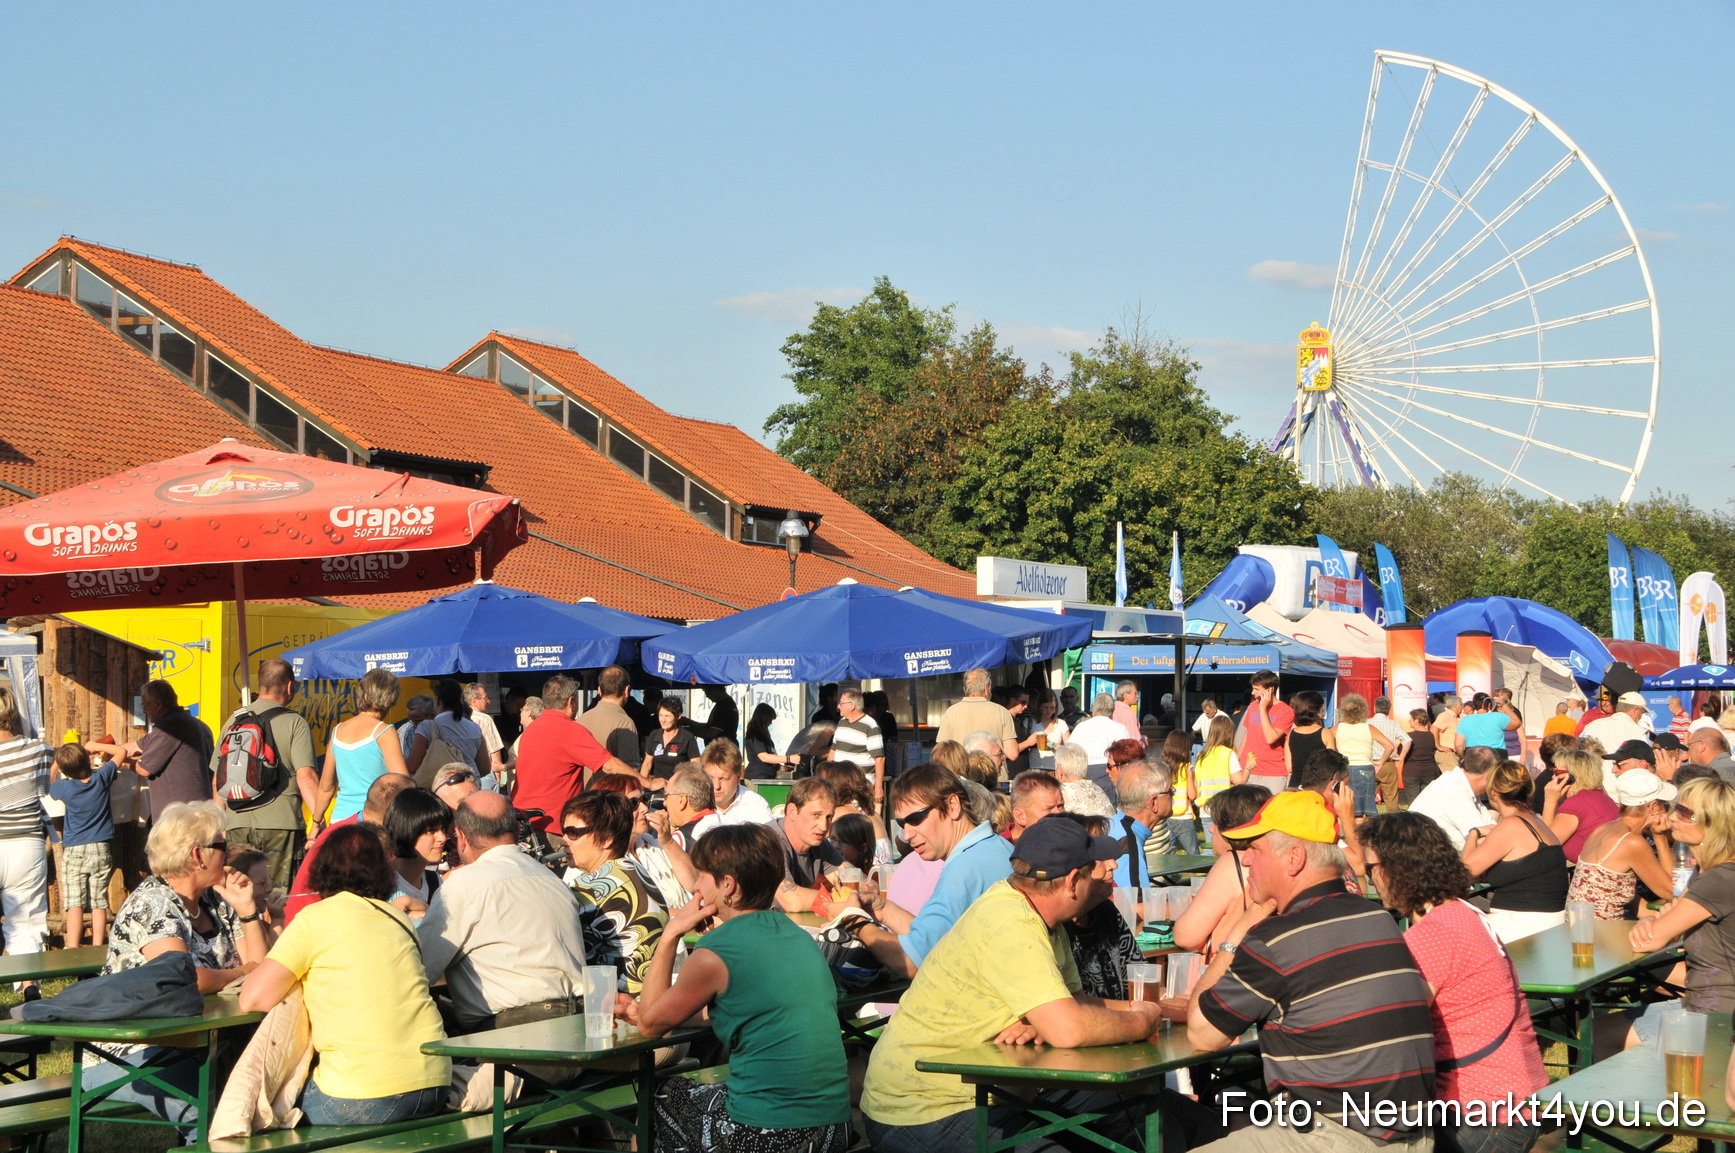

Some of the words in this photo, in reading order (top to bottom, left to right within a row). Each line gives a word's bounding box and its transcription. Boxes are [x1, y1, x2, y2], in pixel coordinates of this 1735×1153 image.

[353, 528, 382, 538] SOFT
[390, 526, 433, 536] DRINKS
[52, 546, 82, 557] SOFT
[92, 542, 138, 554] DRINKS
[1324, 558, 1344, 576] BR
[1381, 567, 1396, 584] BR
[1609, 567, 1629, 589] BR
[1636, 576, 1656, 599] BR
[1654, 580, 1674, 600] BR
[1092, 653, 1109, 663] AIR
[1131, 656, 1149, 665] Der
[1212, 655, 1270, 664] Fahrradsattel
